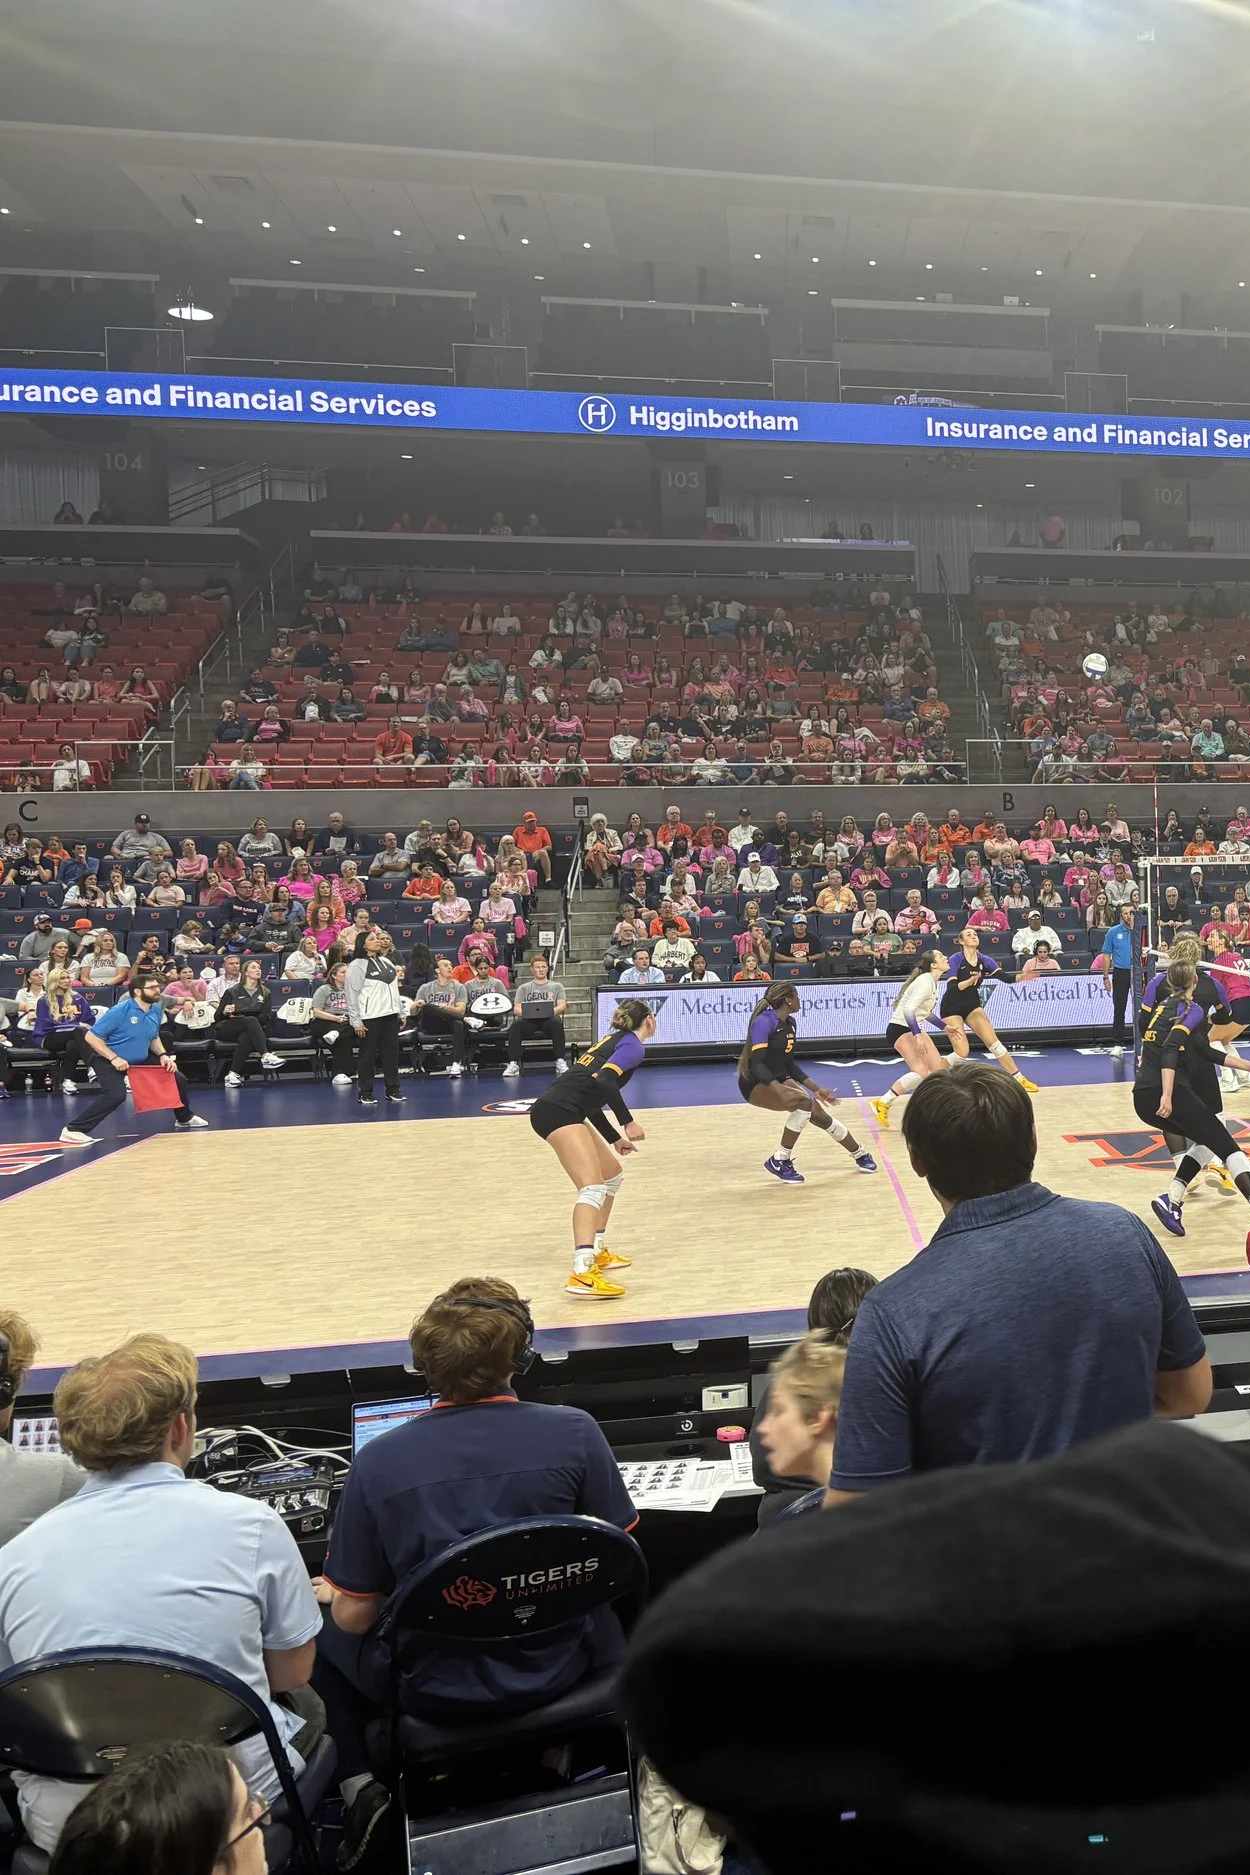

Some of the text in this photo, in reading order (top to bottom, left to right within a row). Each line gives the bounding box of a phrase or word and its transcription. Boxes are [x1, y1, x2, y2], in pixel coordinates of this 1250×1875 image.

[105, 384, 161, 407] and
[168, 385, 303, 412] Financial
[310, 391, 437, 418] Services
[629, 405, 799, 432] Higginbotham
[926, 417, 1048, 441] Insurance
[1053, 419, 1097, 443] and
[1103, 423, 1208, 447] Financial
[104, 453, 143, 471] 104
[665, 472, 700, 489] 103
[1154, 488, 1183, 505] 102
[19, 800, 38, 821] C
[1003, 793, 1014, 811] B
[1010, 981, 1079, 1003] Medical
[785, 1039, 794, 1053] 5
[501, 1557, 599, 1590] TIGERS
[506, 1572, 593, 1600] UNLIMITED
